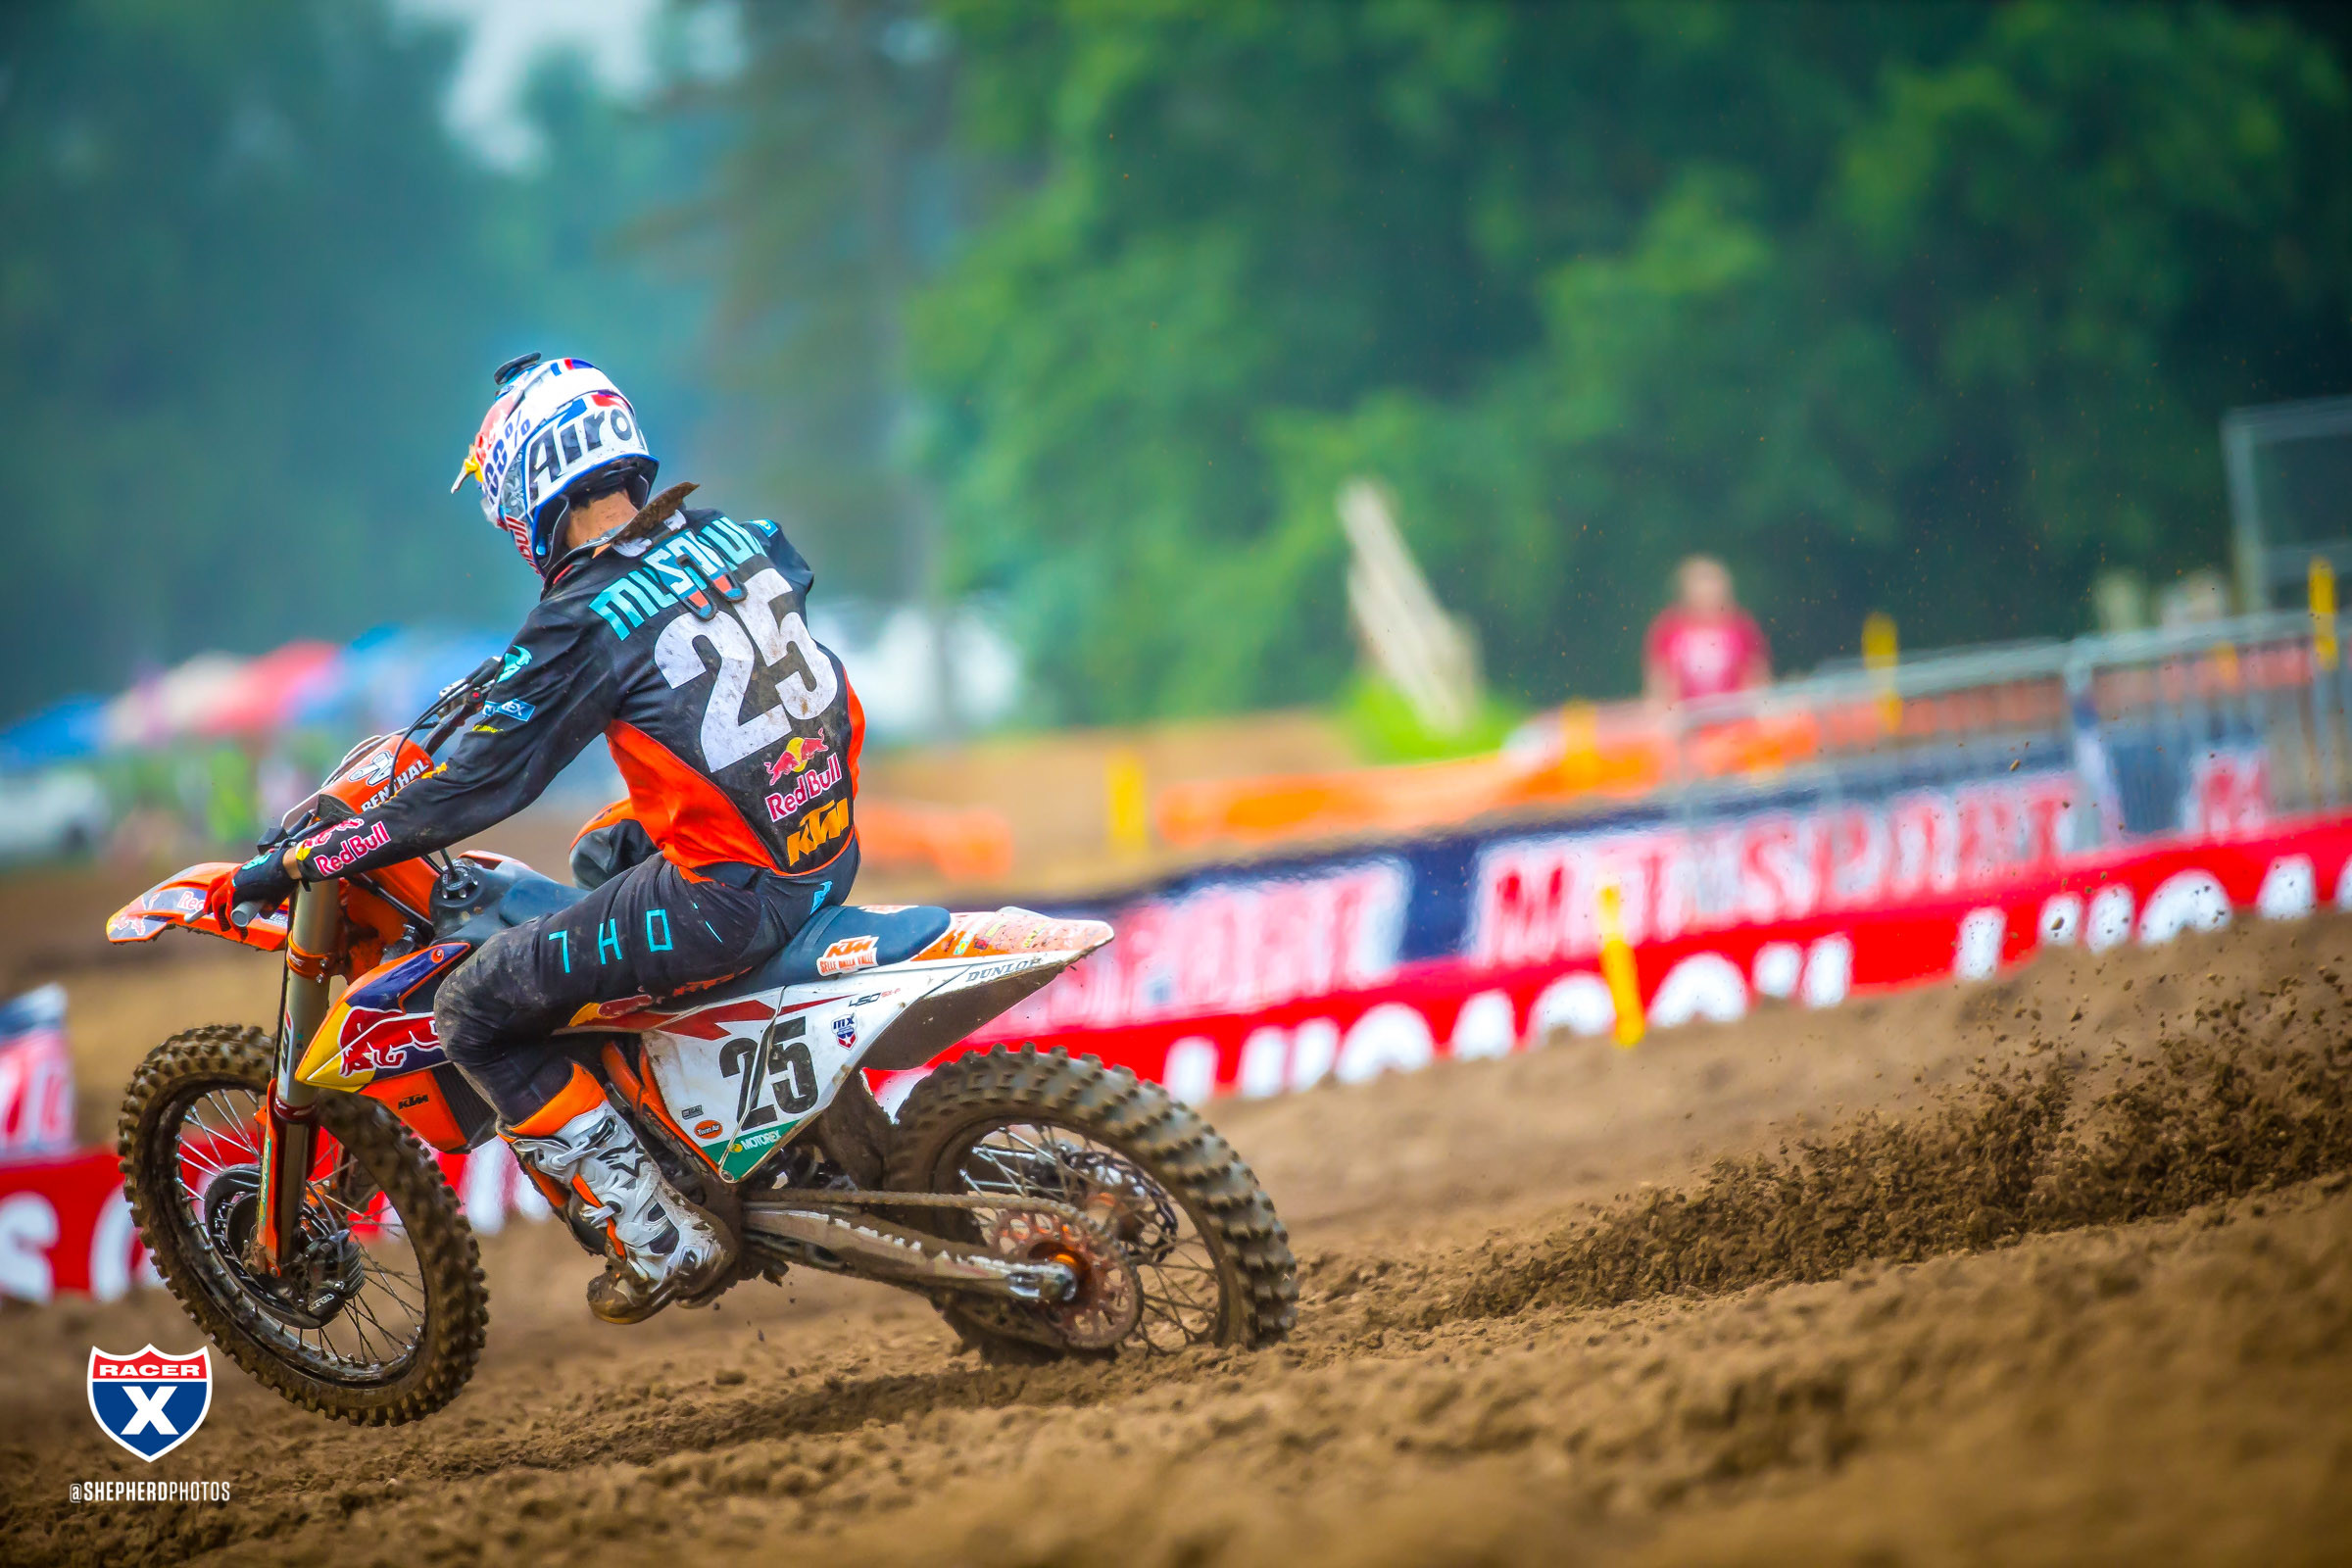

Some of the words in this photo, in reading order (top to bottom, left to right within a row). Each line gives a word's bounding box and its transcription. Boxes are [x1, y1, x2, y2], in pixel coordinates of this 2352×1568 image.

[529, 399, 644, 506] Airo
[654, 568, 838, 772] 25
[765, 773, 809, 822] Red
[805, 752, 842, 799] Bull
[787, 797, 850, 866] KTM
[315, 842, 355, 877] Red
[350, 820, 391, 859] Bull
[826, 939, 873, 957] KTM
[819, 960, 837, 973] SELLE
[839, 957, 856, 968] DALLA
[858, 952, 874, 964] VALLE
[965, 957, 1043, 983] DUNLOP
[848, 992, 881, 1006] 450
[718, 1016, 819, 1131] 25
[397, 1093, 430, 1110] KTM
[697, 1126, 710, 1136] Twin
[741, 1130, 782, 1151] MOTOREX
